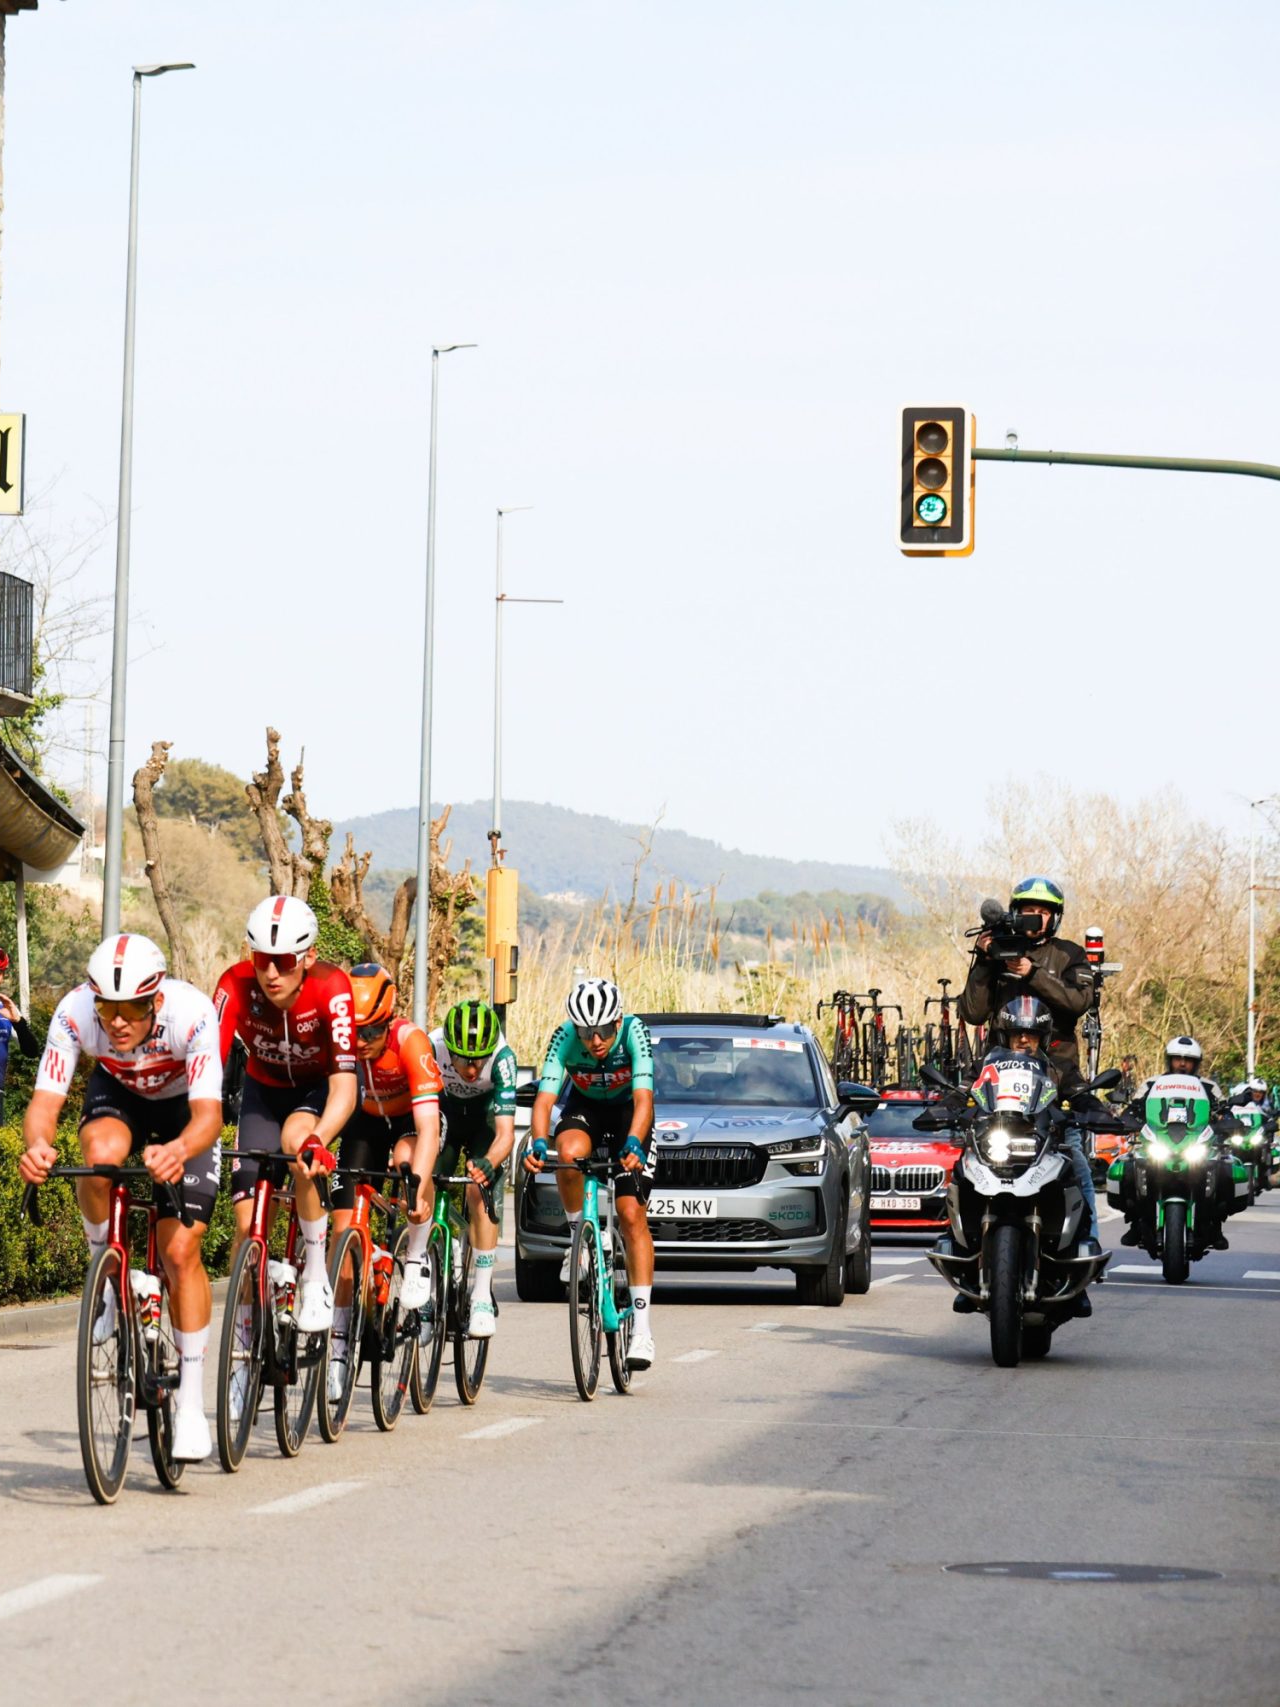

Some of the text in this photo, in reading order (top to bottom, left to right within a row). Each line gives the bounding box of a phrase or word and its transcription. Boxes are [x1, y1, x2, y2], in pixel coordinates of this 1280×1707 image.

[577, 1070, 631, 1082] KERN
[1013, 1082, 1030, 1094] 69
[1155, 1084, 1201, 1092] Kawasaki
[657, 1120, 681, 1128] A
[709, 1119, 783, 1129] Volta
[681, 1200, 713, 1215] NKV
